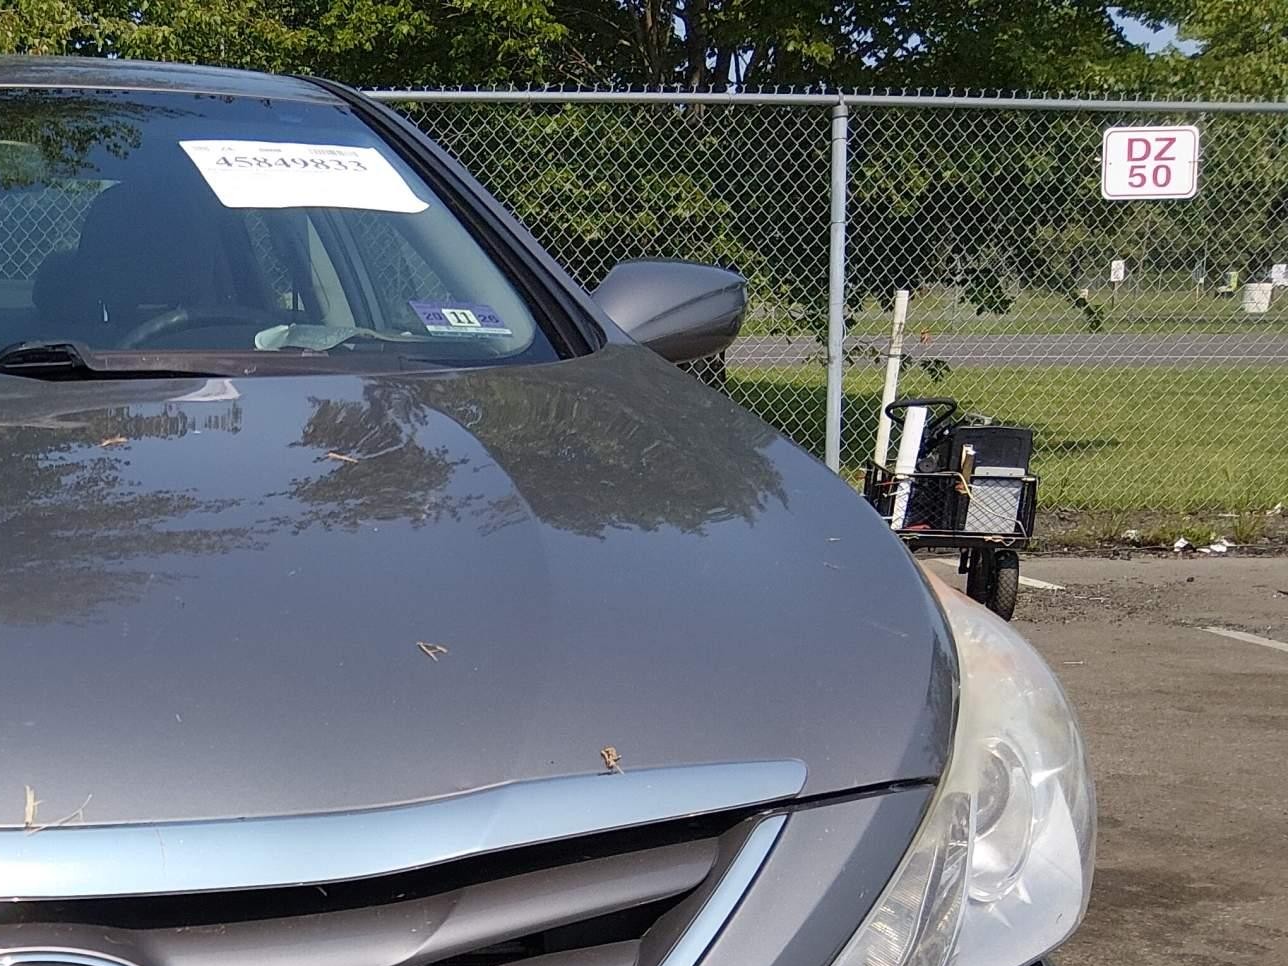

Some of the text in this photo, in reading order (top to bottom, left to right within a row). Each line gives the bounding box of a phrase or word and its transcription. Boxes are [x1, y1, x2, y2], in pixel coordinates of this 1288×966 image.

[1127, 137, 1177, 162] DZ
[215, 155, 369, 172] 45849833
[1128, 164, 1172, 188] 50
[450, 311, 475, 324] 11
